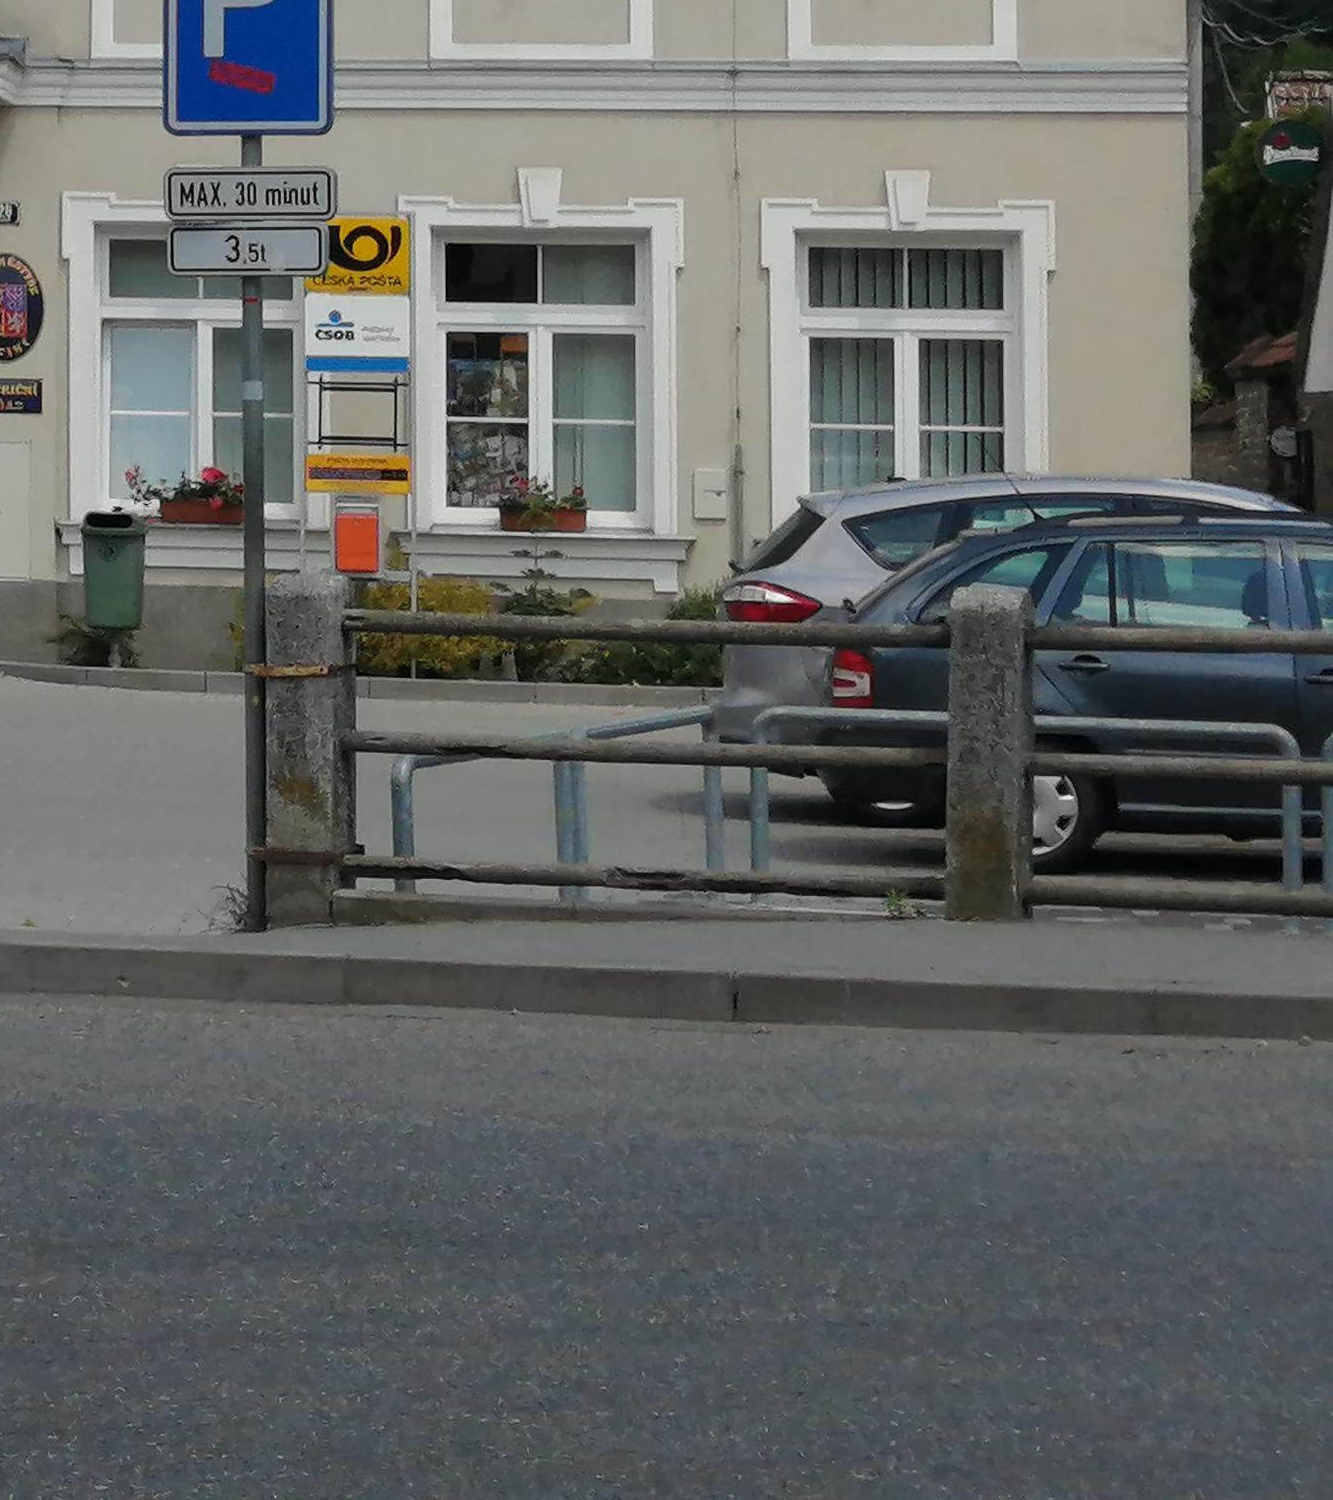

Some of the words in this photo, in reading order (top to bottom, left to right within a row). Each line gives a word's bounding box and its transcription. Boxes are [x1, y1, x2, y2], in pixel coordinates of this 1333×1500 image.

[179, 180, 228, 207] MAX.
[234, 180, 258, 207] 30
[265, 180, 321, 207] minut
